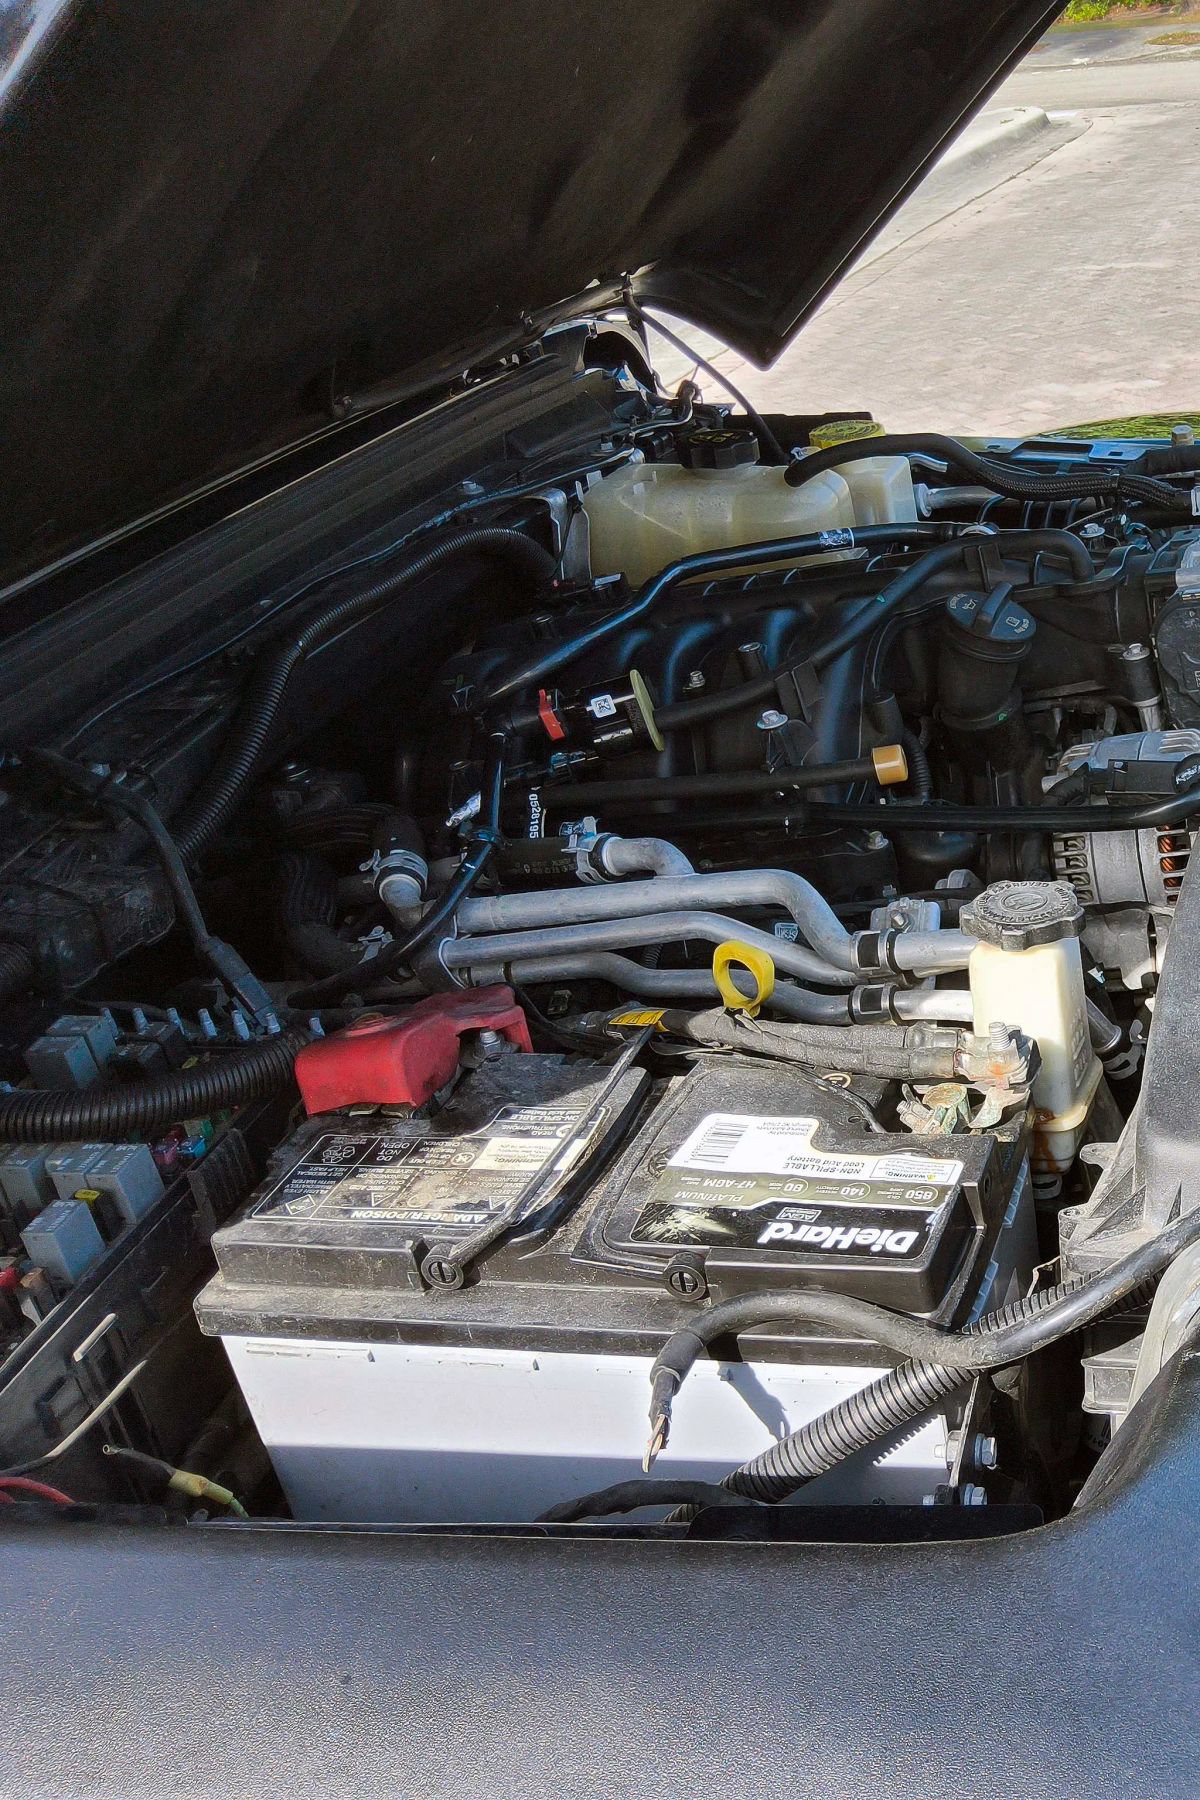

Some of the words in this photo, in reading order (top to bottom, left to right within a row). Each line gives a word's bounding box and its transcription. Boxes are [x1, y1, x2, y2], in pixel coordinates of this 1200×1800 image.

[787, 1156, 821, 1165] Battery
[823, 1159, 842, 1167] Acid
[783, 1162, 861, 1175] NON-SPILLABLE
[703, 1178, 757, 1189] H7-AGM
[783, 1183, 803, 1192] 80
[674, 1191, 744, 1202] PLATINUM
[840, 1187, 865, 1197] 140
[905, 1190, 933, 1200] 850
[780, 1212, 815, 1220] AGM
[757, 1222, 919, 1254] DieHard
